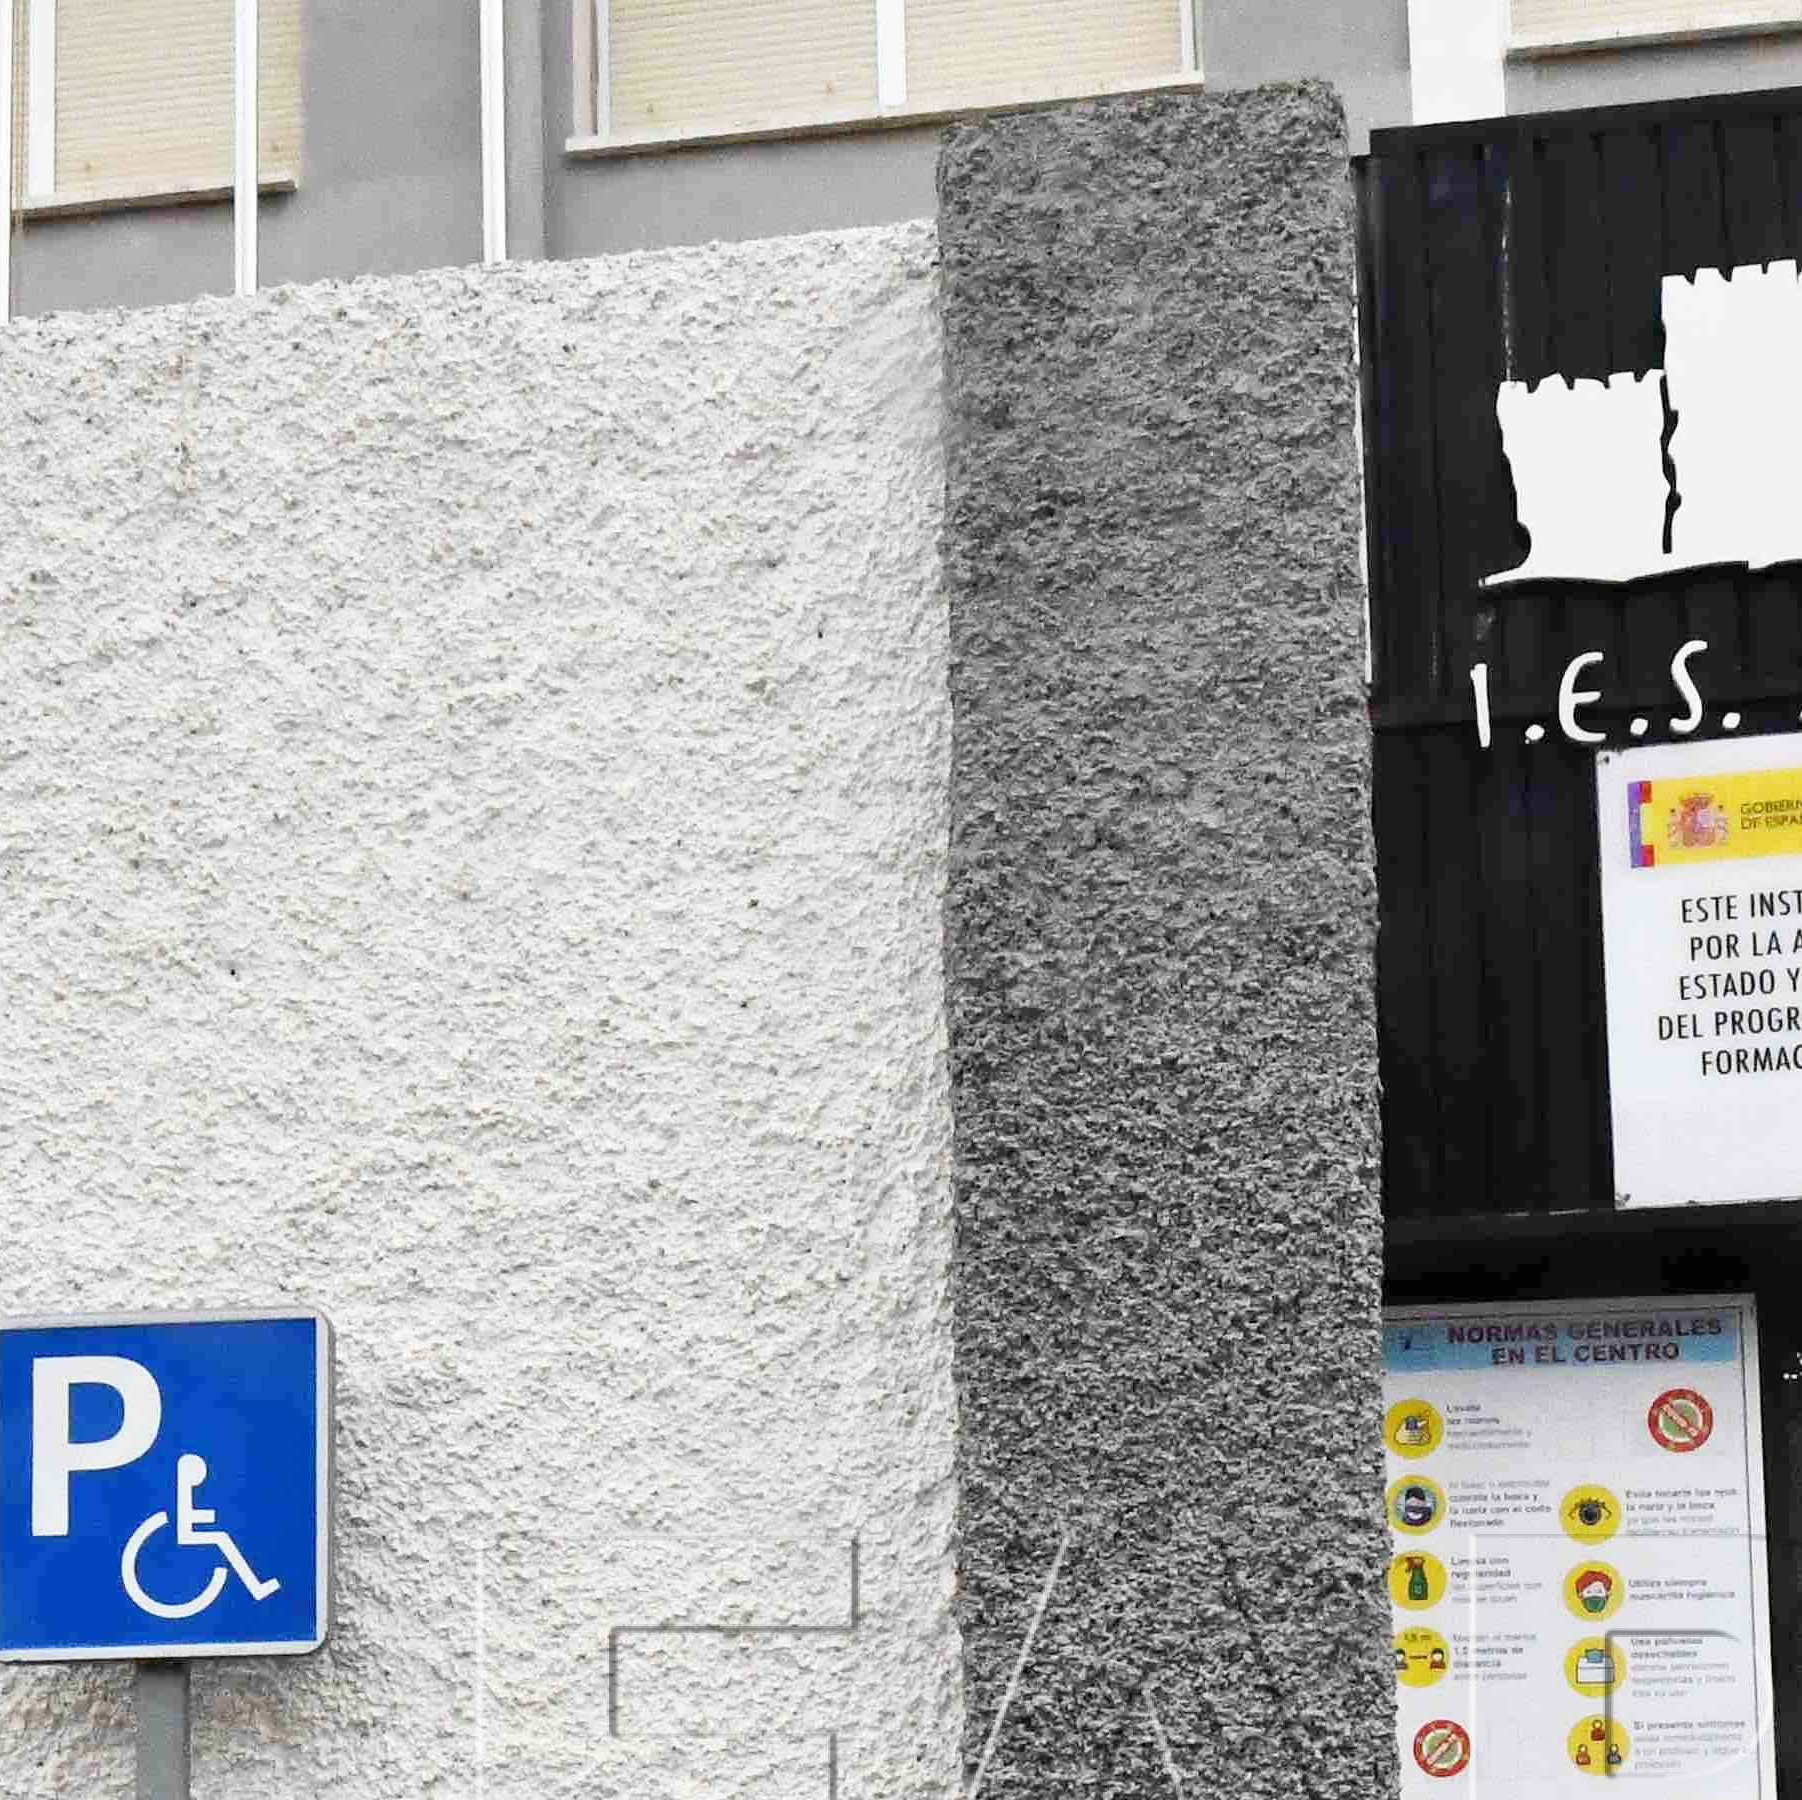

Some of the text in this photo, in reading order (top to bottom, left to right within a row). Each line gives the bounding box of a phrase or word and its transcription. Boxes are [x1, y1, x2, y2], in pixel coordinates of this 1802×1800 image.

[1469, 639, 1743, 749] I.E.S.
[1740, 818, 1759, 831] DE
[1681, 895, 1738, 924] ESTE
[1690, 933, 1740, 962] POR
[1752, 930, 1782, 957] LA
[1679, 968, 1775, 1001] ESTADO
[1786, 967, 1801, 993] Y
[1658, 1013, 1703, 1041] DEL
[1447, 1317, 1723, 1345] NORMAS GENERALES
[1492, 1341, 1680, 1365] EN EL CENTRO
[27, 1355, 165, 1540] P
